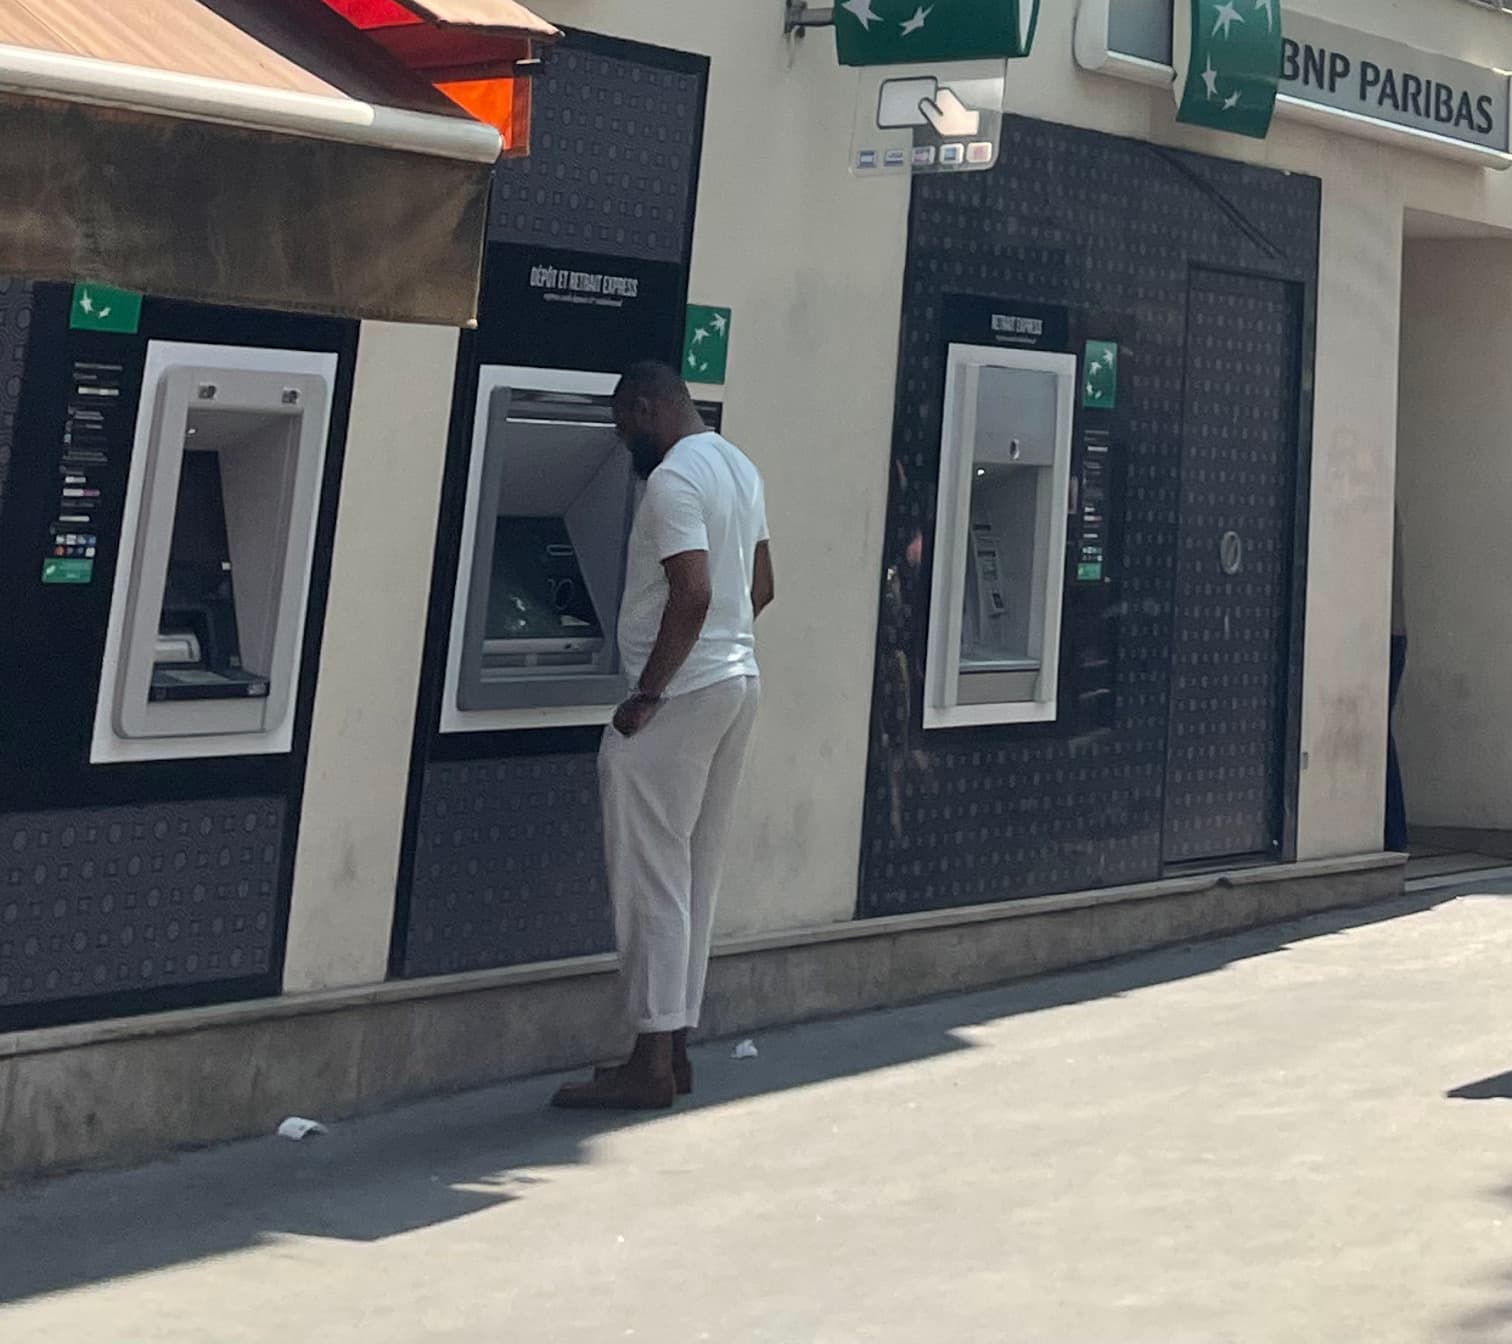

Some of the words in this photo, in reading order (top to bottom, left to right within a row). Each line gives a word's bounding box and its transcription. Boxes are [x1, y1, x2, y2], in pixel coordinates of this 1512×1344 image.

[1281, 38, 1350, 92] BNP
[1360, 61, 1493, 134] PARIBAS
[602, 276, 638, 296] EXPRESS
